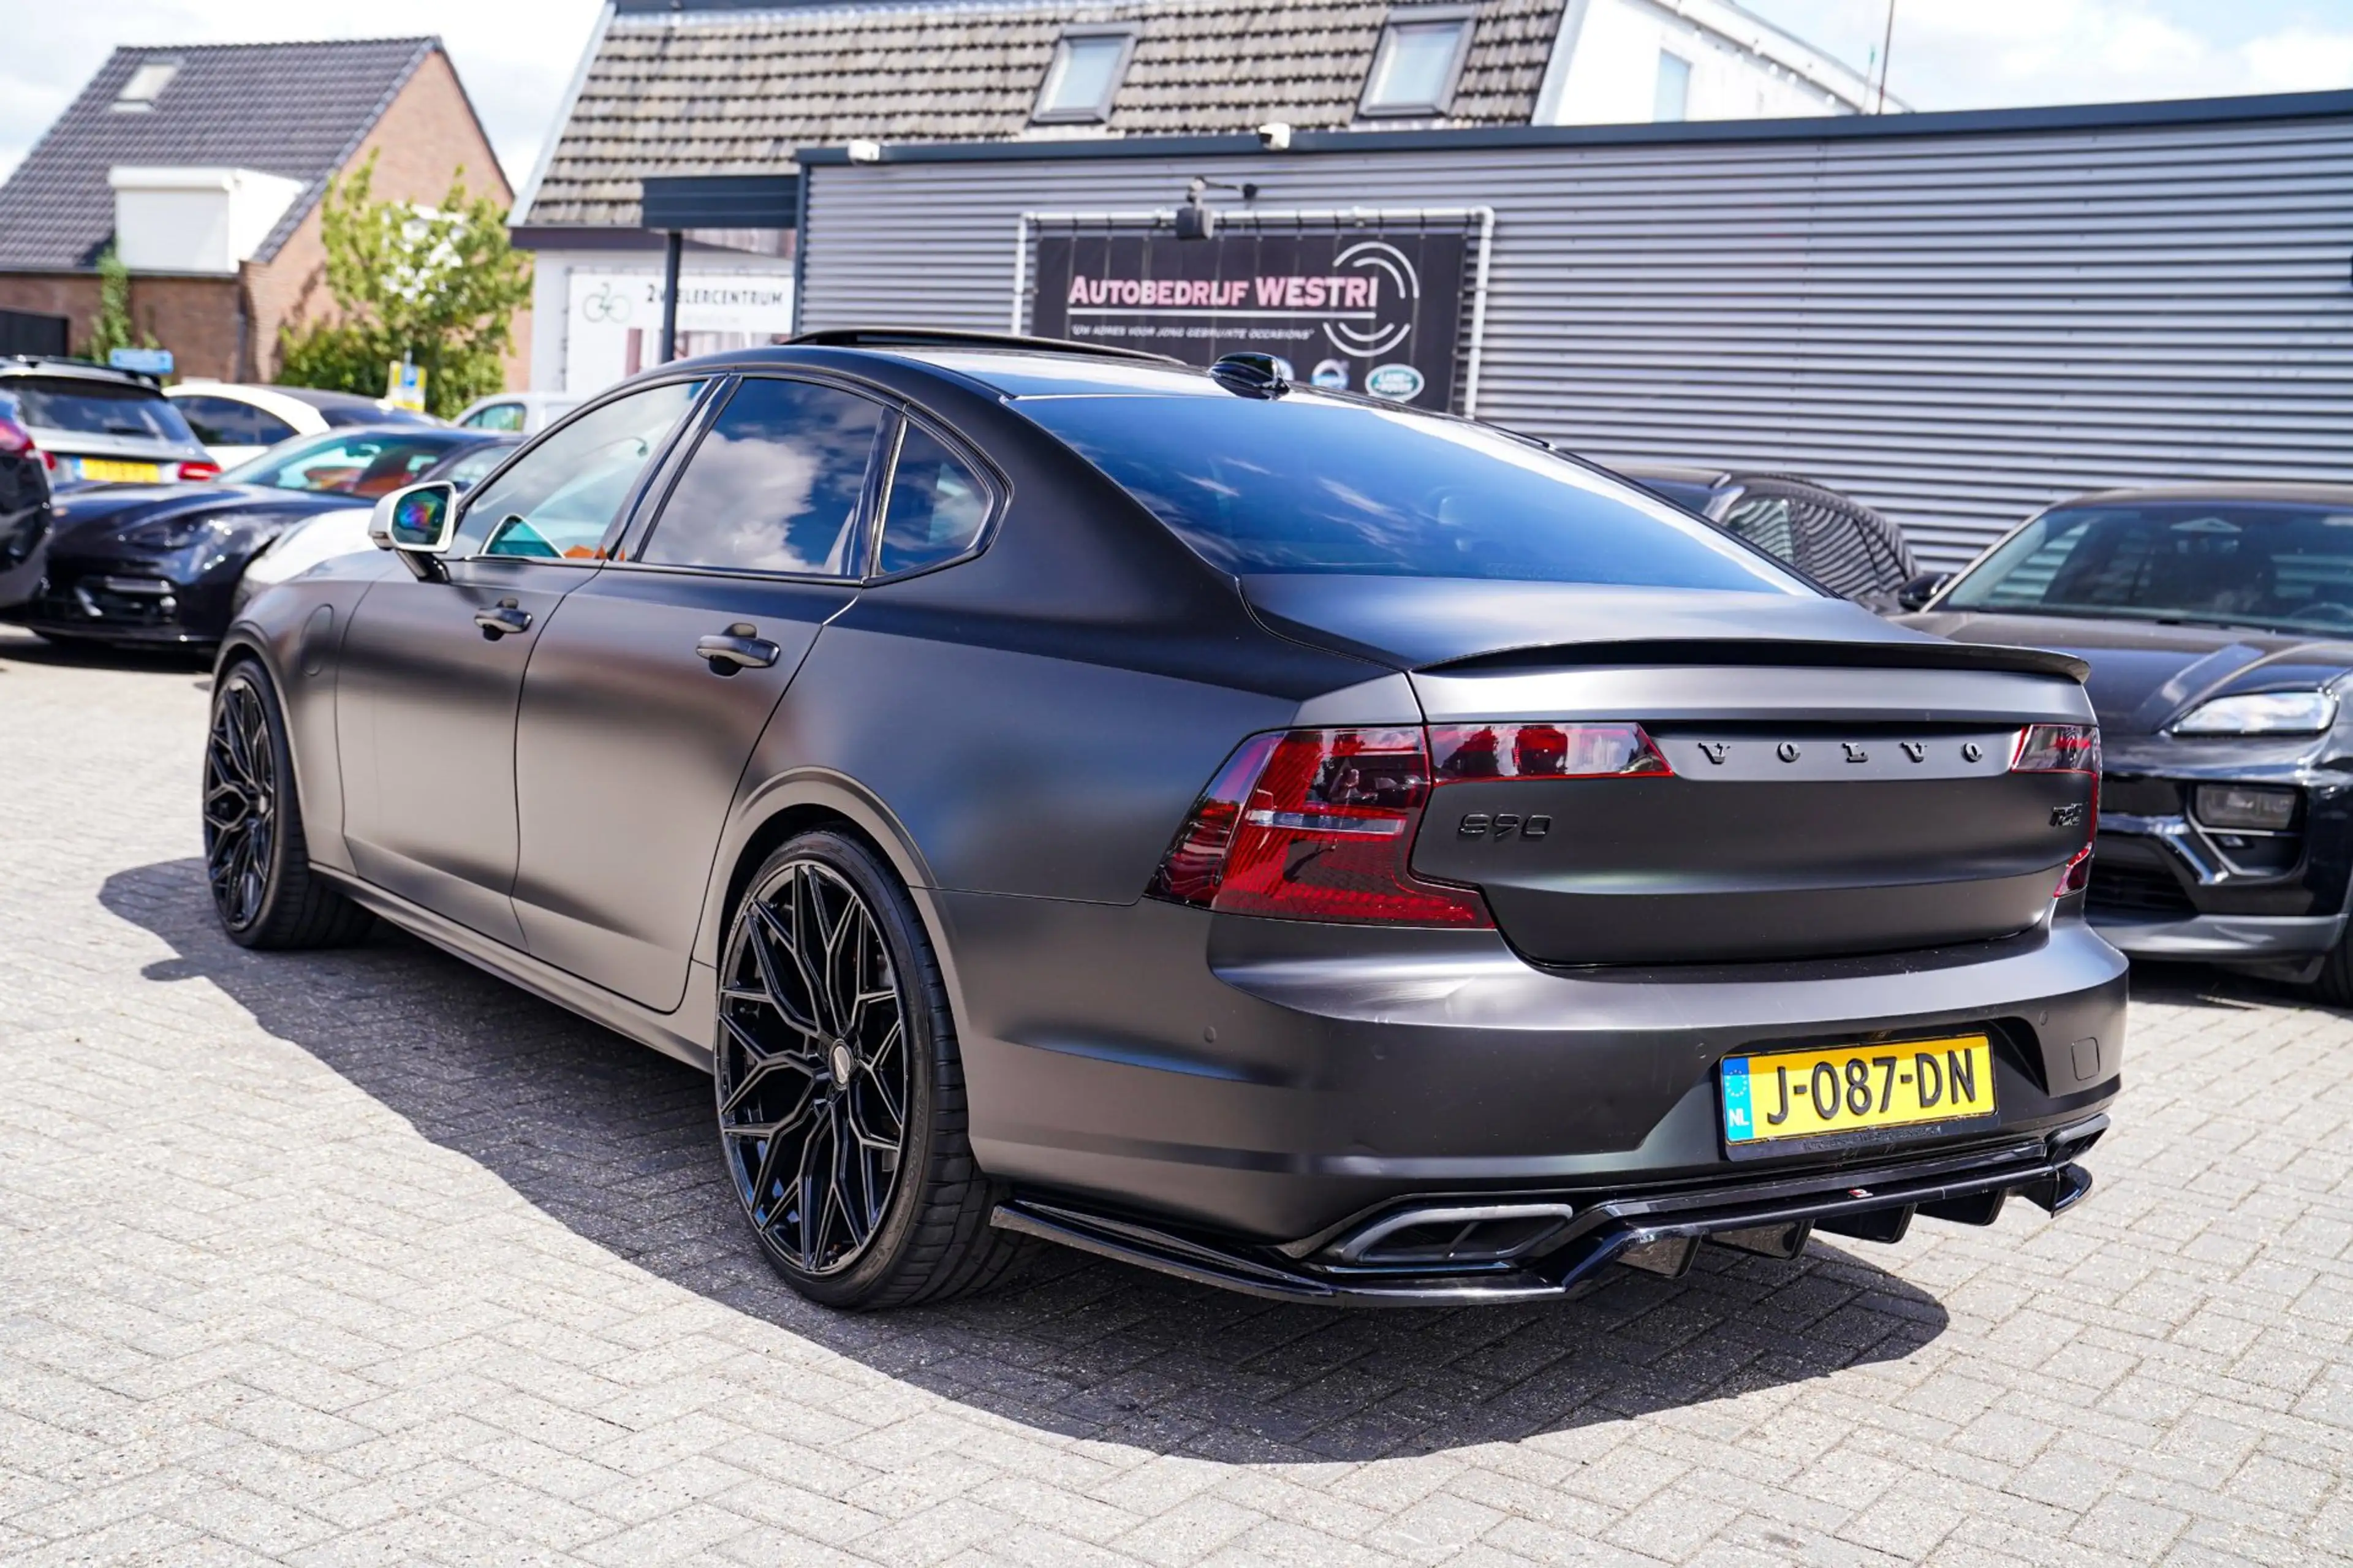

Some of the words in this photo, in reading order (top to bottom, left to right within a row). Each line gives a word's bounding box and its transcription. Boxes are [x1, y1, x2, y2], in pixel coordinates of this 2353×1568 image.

[1069, 275, 1249, 306] AUTOBEDRIJF
[1255, 276, 1378, 307] WESTRI
[1698, 741, 1983, 765] VOLVO
[1458, 814, 1553, 838] S90
[1767, 1048, 1976, 1125] J-087-DN
[1729, 1108, 1750, 1127] NL
